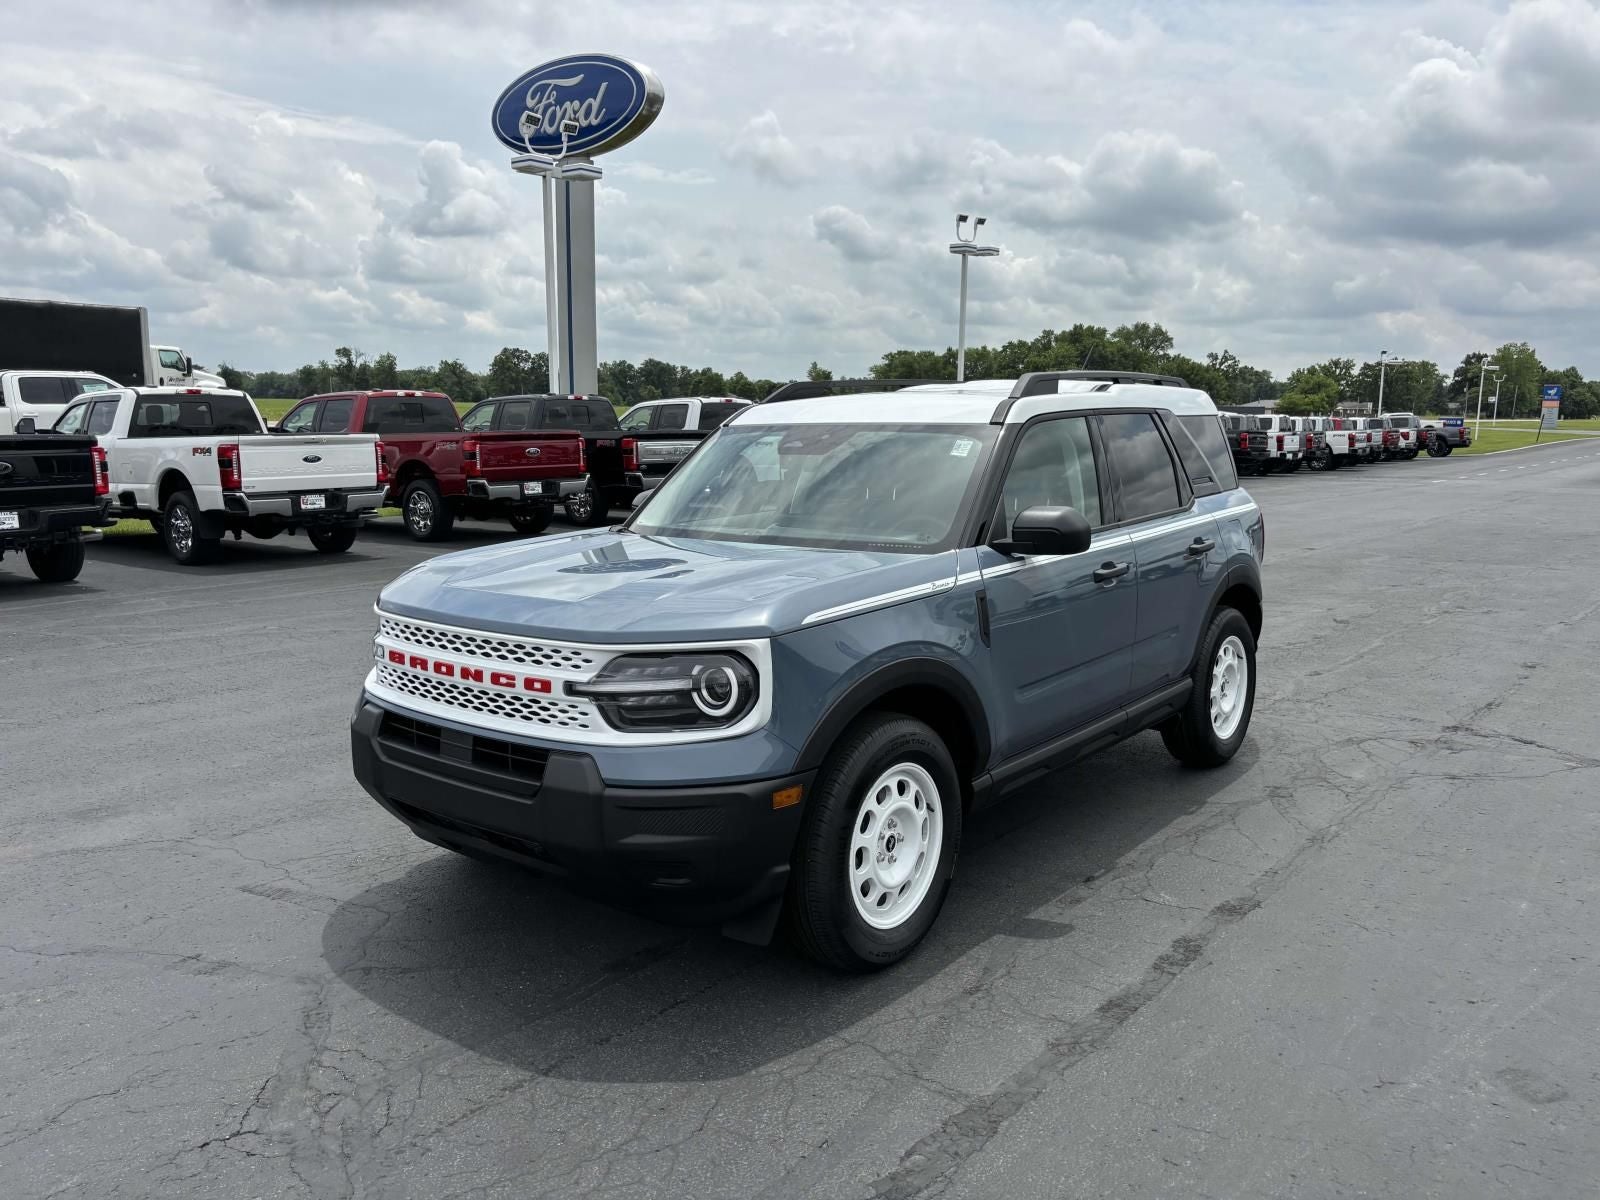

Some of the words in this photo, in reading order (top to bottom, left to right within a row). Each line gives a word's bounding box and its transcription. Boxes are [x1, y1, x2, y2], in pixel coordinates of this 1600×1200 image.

[518, 73, 609, 138] Ford
[192, 447, 212, 456] FX4
[388, 650, 552, 694] BRONCO
